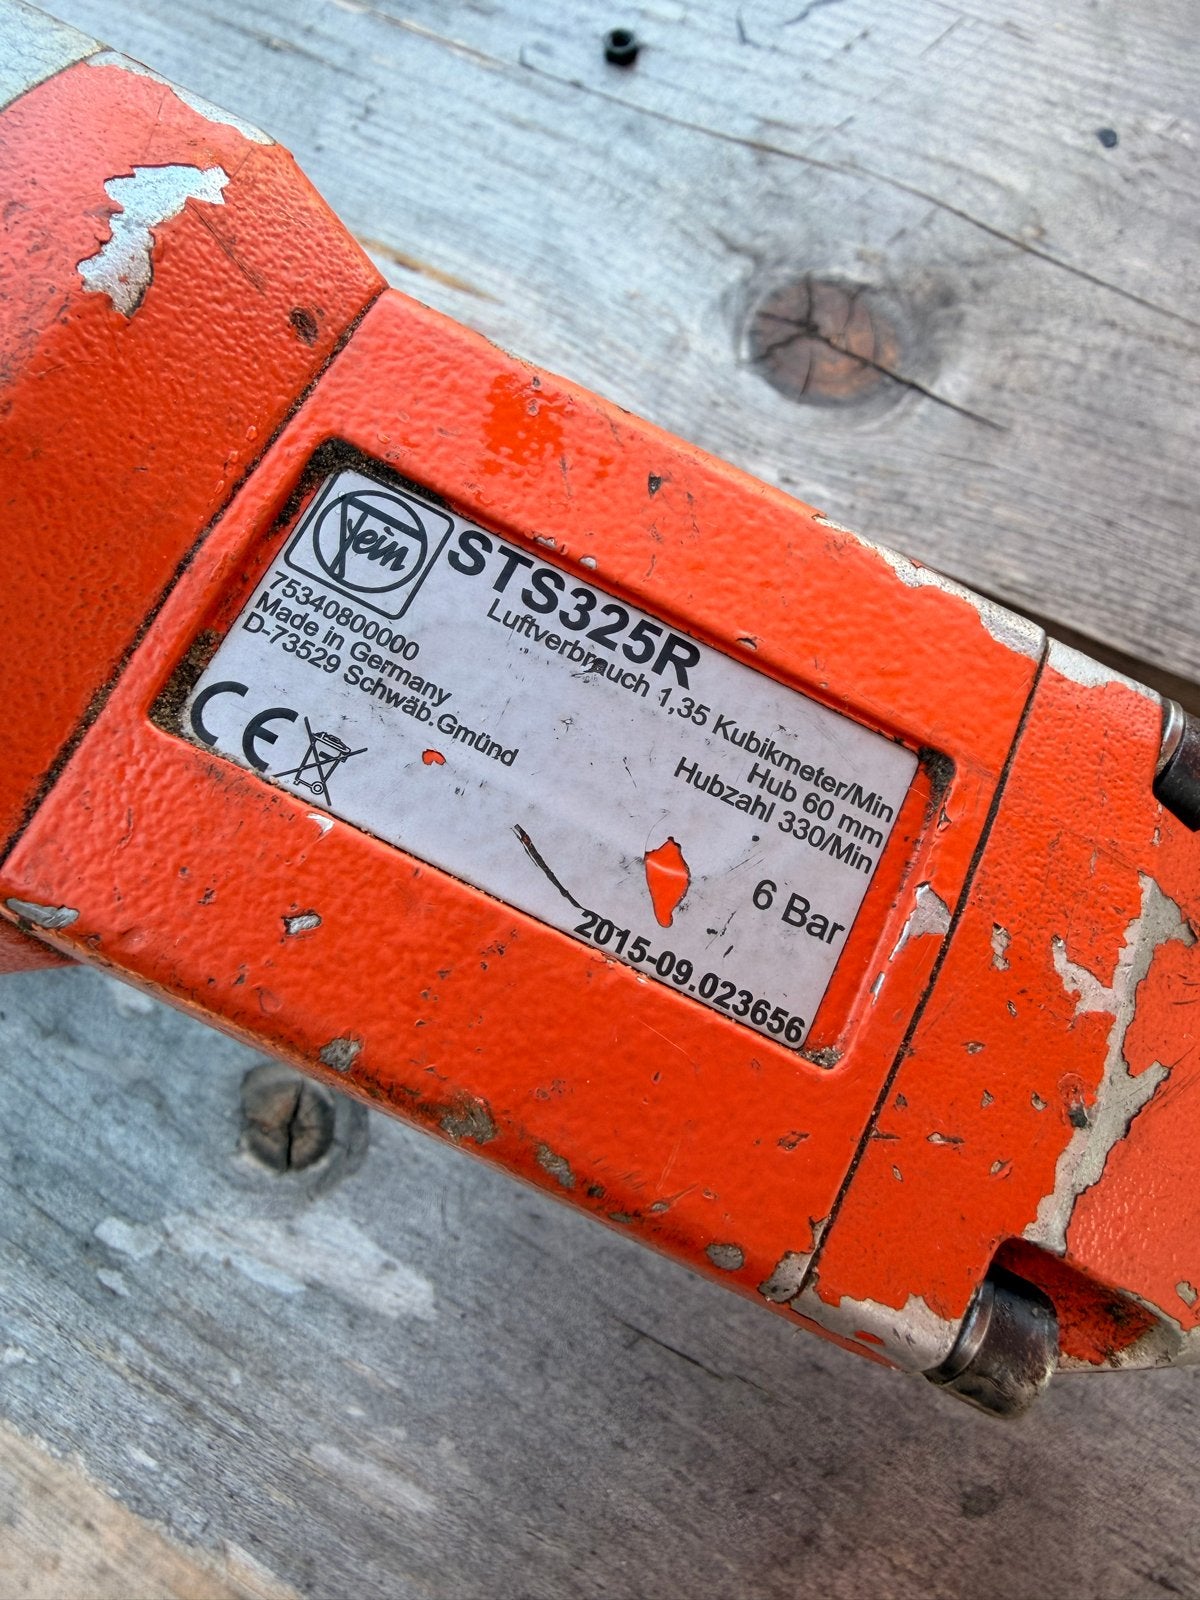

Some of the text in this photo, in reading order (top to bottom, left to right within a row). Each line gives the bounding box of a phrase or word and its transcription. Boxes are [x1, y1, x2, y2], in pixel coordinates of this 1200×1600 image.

[241, 612, 342, 674] D-73529
[254, 591, 452, 707] Made in Germany
[269, 570, 420, 661] 75340800000
[447, 529, 701, 690] STS325R
[190, 680, 299, 772] CE
[486, 598, 894, 823] Luftverbrauch 1,35 Kubikmeter/Min
[673, 756, 873, 875] Hubzahl 330/Min
[747, 762, 884, 849] Hub 60 mm
[752, 879, 846, 945] 6 Bar
[573, 910, 806, 1043] 2015-09.023656
